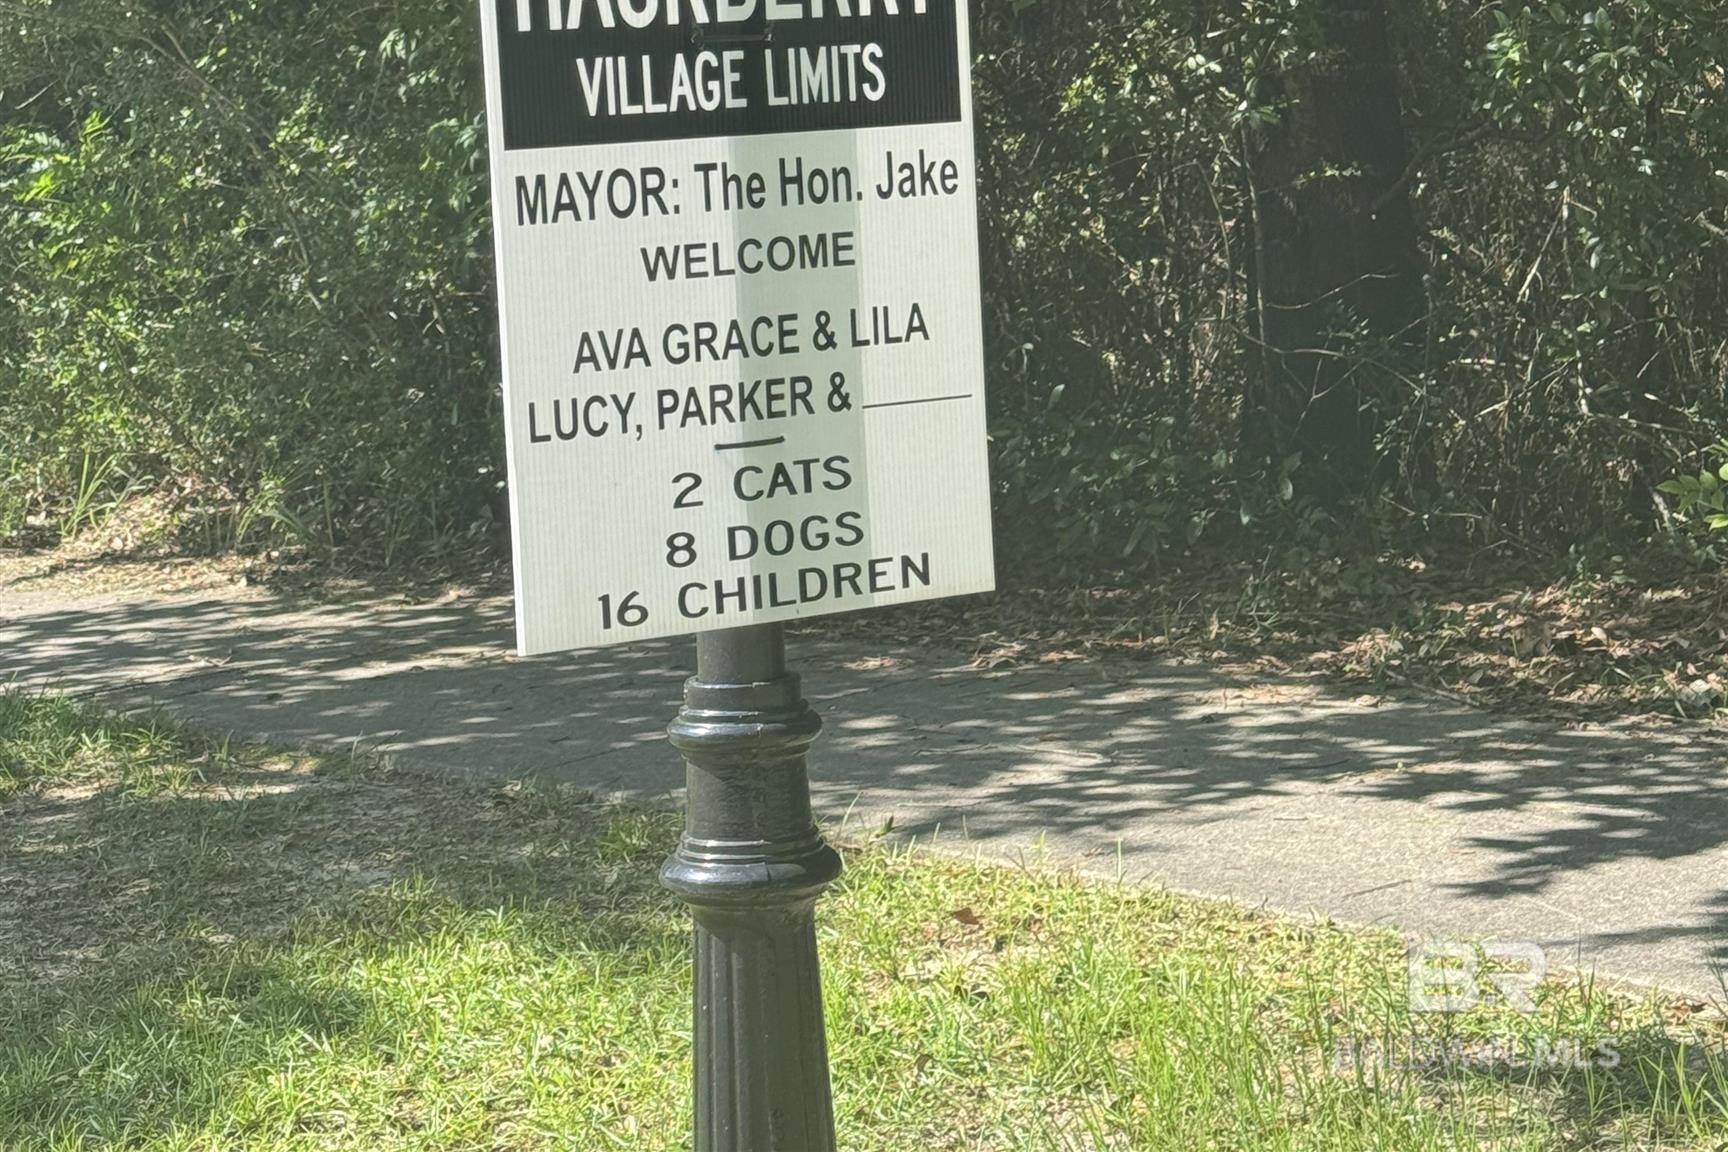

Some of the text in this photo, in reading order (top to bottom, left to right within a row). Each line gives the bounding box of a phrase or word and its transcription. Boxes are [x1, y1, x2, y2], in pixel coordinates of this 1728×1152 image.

[576, 42, 886, 117] VILLAGE LIMITS
[514, 149, 959, 226] MAYOR: The Hon. Jake
[640, 231, 856, 282] WELCOME
[572, 302, 930, 374] AVA GRACE & LILA
[528, 371, 853, 444] LUCY, PARKER &
[671, 455, 853, 509] 2 CATS
[665, 511, 865, 568] 8 DOGS
[597, 552, 931, 630] 16 CHILDREN
